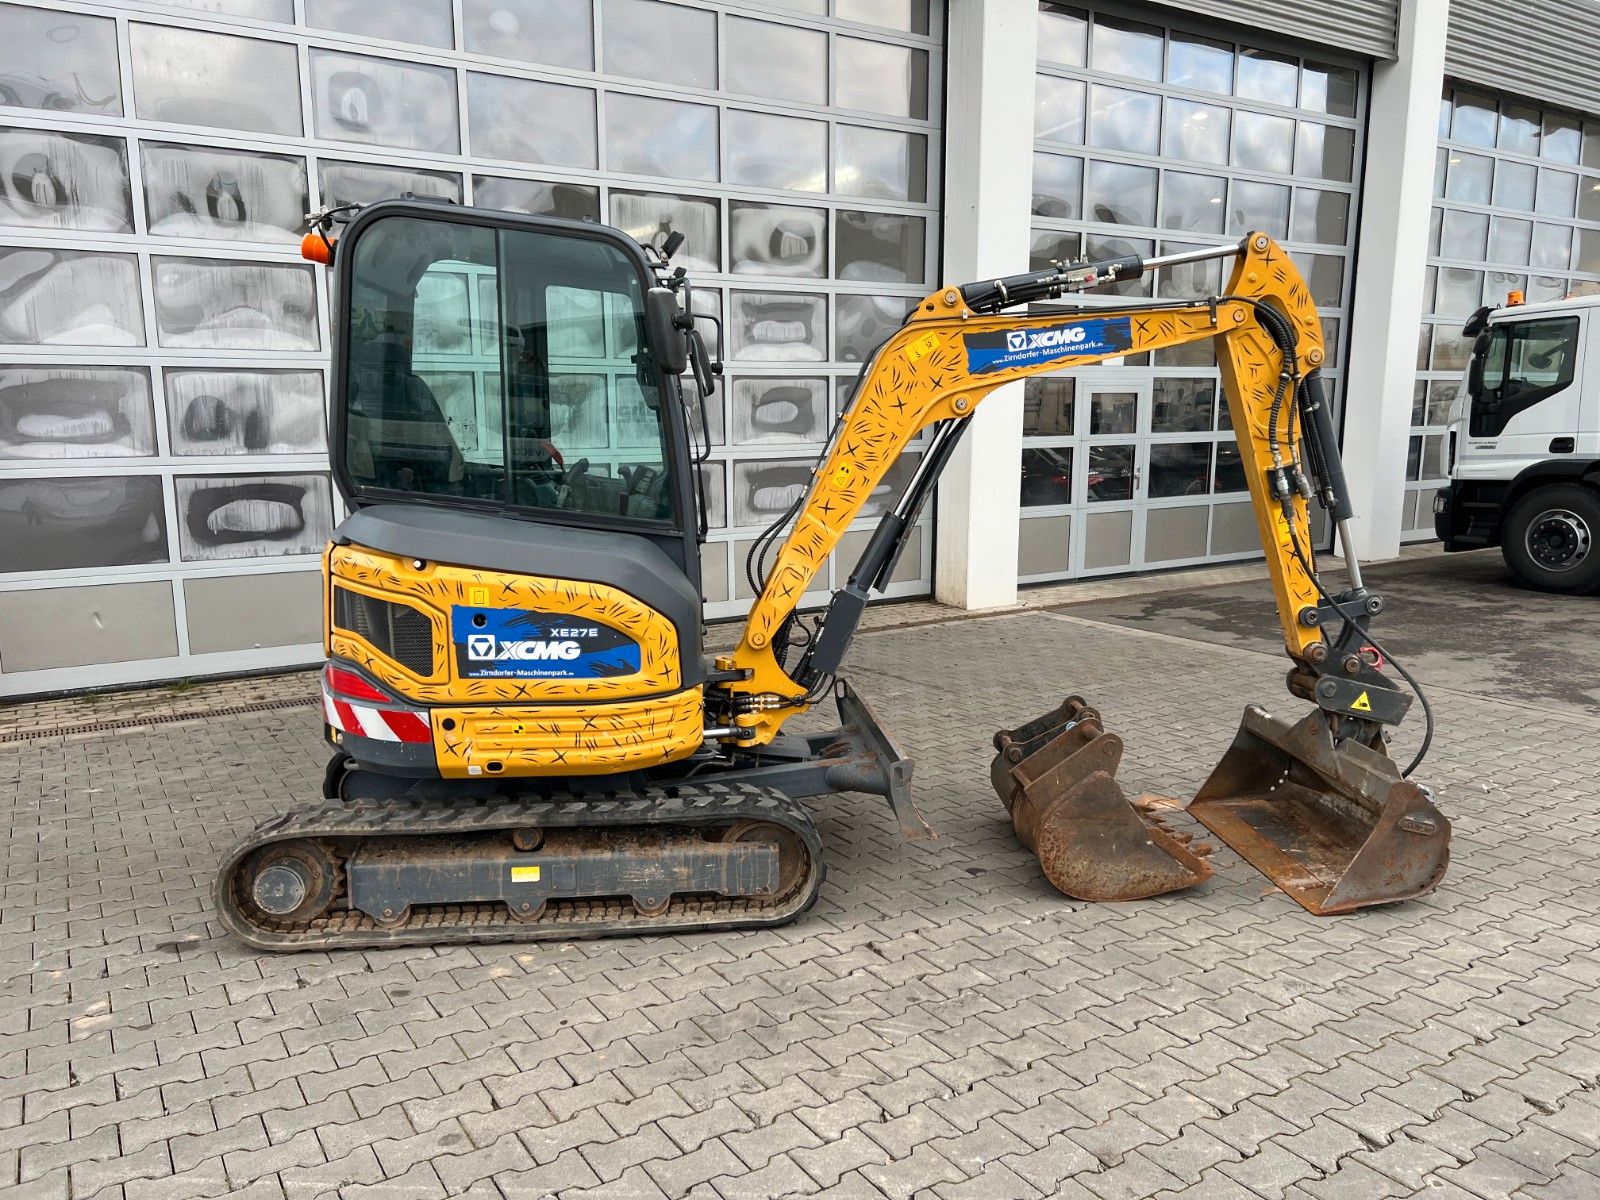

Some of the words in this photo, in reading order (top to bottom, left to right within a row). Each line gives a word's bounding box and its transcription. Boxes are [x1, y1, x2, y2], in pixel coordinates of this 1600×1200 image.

[1027, 327, 1086, 349] XCMG
[550, 628, 598, 637] XE27E
[495, 641, 581, 660] XCMG
